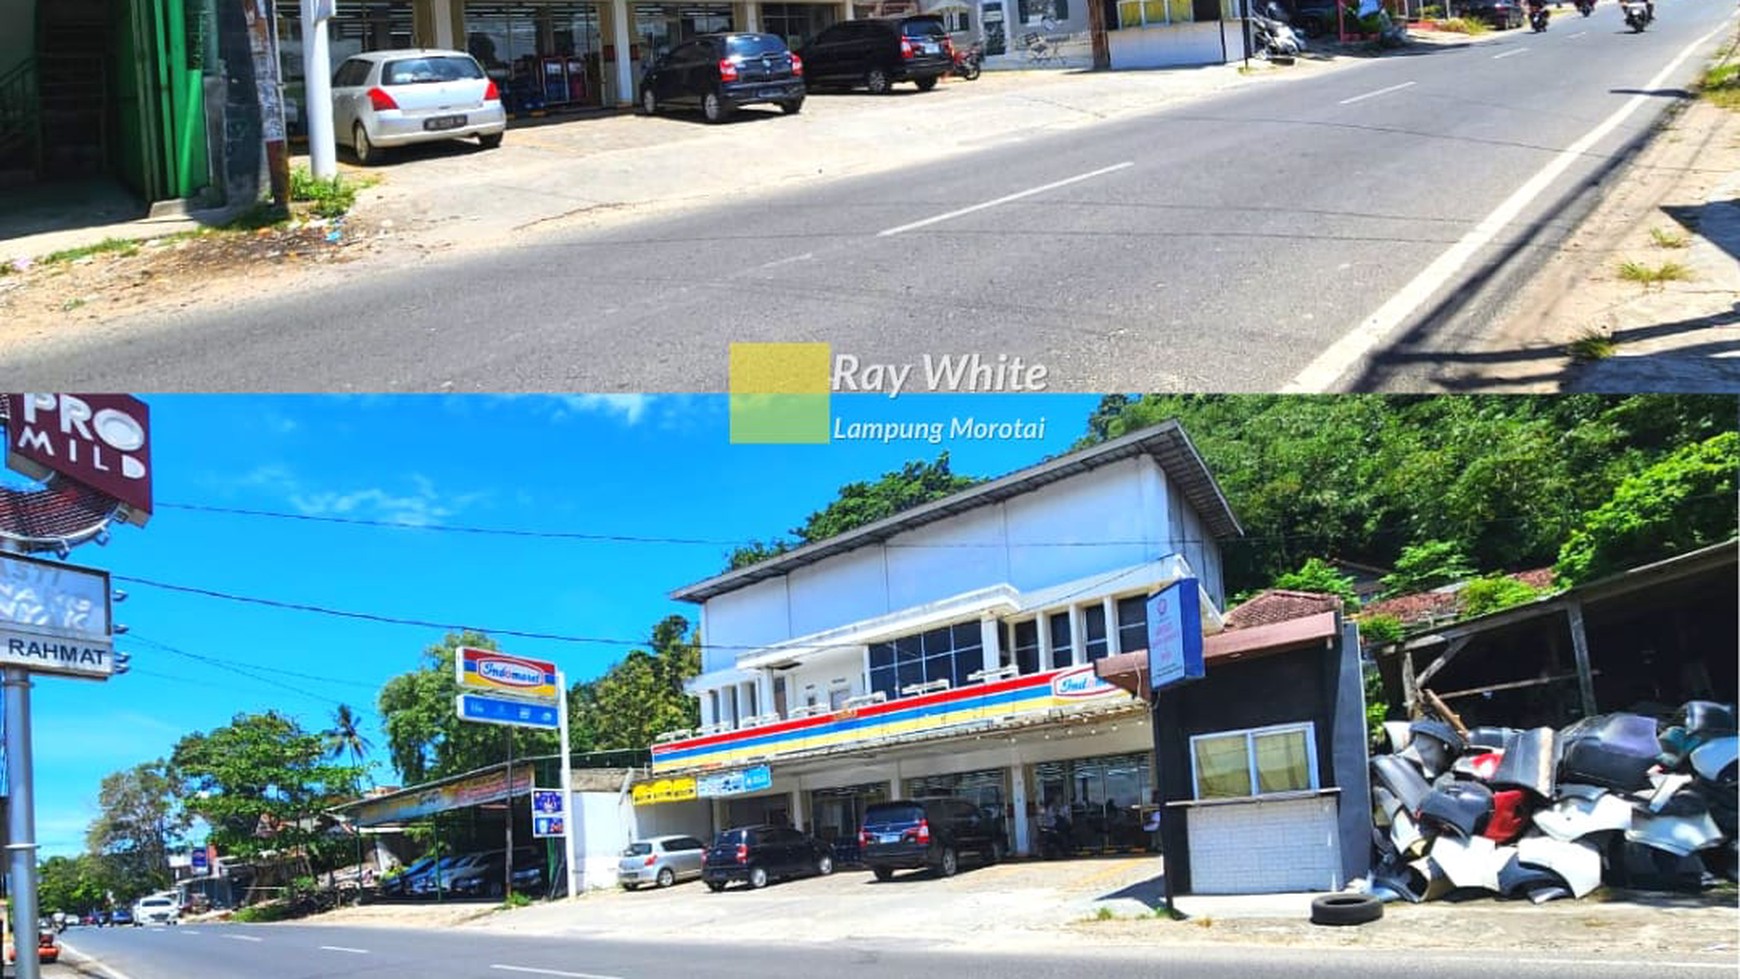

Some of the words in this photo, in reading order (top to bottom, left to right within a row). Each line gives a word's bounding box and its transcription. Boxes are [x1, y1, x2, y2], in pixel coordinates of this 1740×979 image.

[23, 392, 145, 451] PRO
[18, 426, 146, 479] MILD
[8, 638, 106, 665] RAHMAT
